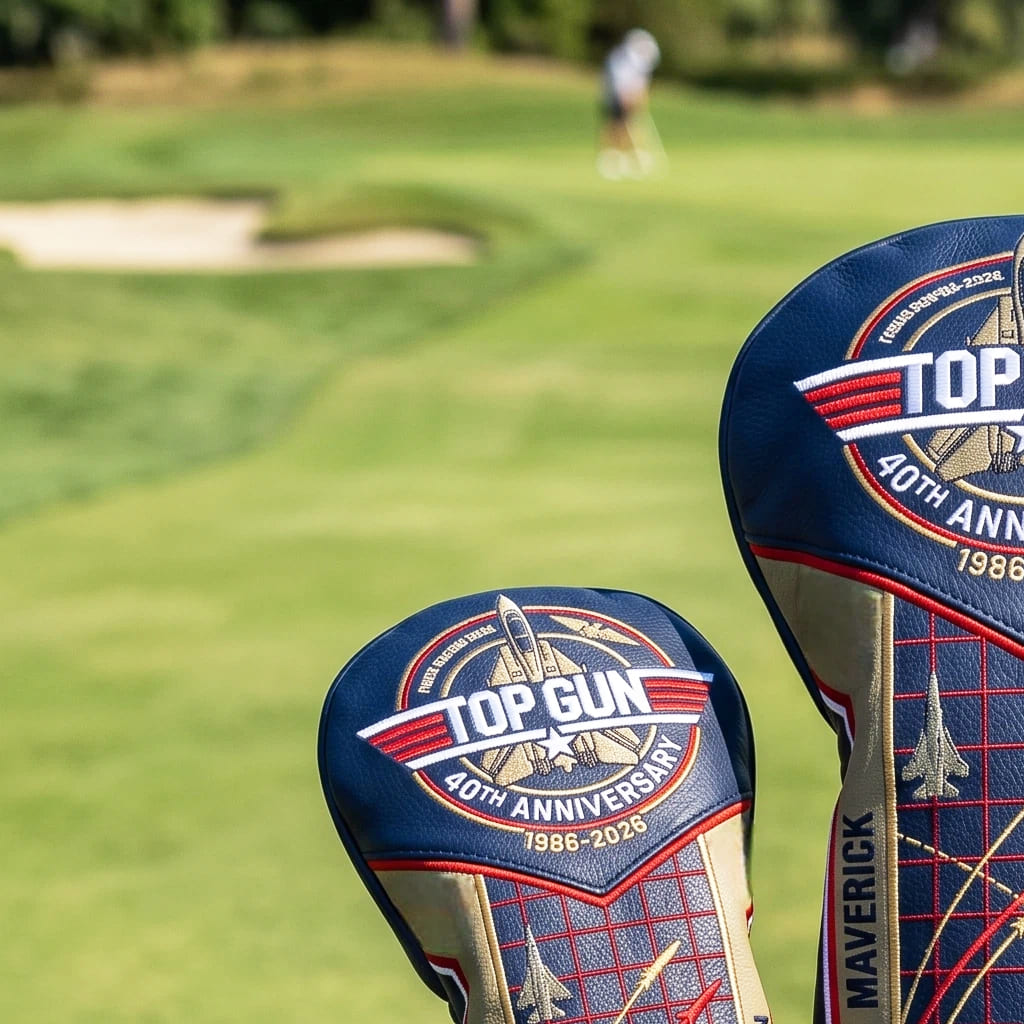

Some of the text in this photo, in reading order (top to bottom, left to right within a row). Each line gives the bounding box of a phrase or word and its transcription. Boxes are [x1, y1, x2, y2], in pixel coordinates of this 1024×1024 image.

[900, 346, 1020, 414] TOP
[877, 453, 950, 508] 40TH
[442, 673, 652, 743] TOP GUN
[445, 734, 683, 822] 40TH ANNIVERSARY
[524, 814, 648, 851] 1986-2026
[842, 811, 878, 1009] MAVERICK
